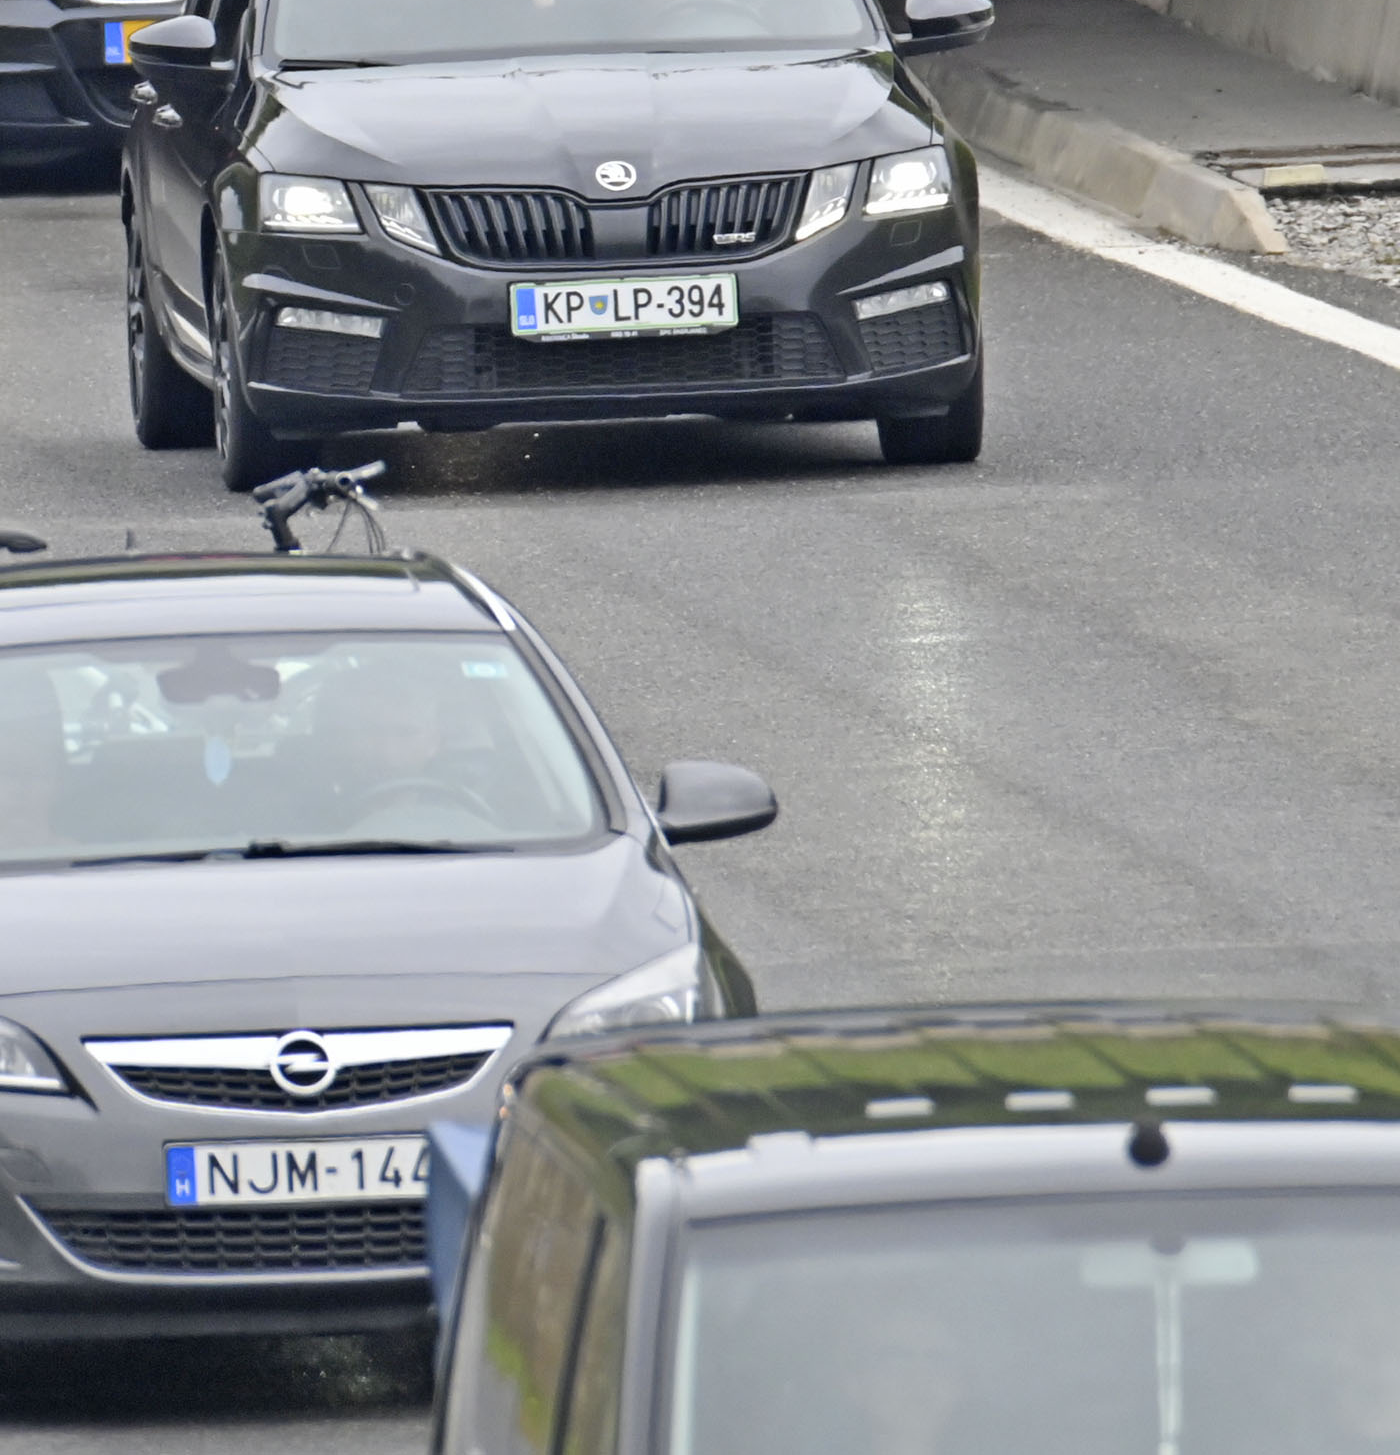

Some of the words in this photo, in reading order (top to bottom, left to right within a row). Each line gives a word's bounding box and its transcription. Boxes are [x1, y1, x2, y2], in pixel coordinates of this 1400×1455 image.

[543, 291, 584, 324] KP
[613, 283, 725, 322] LP-394
[176, 1178, 190, 1195] H
